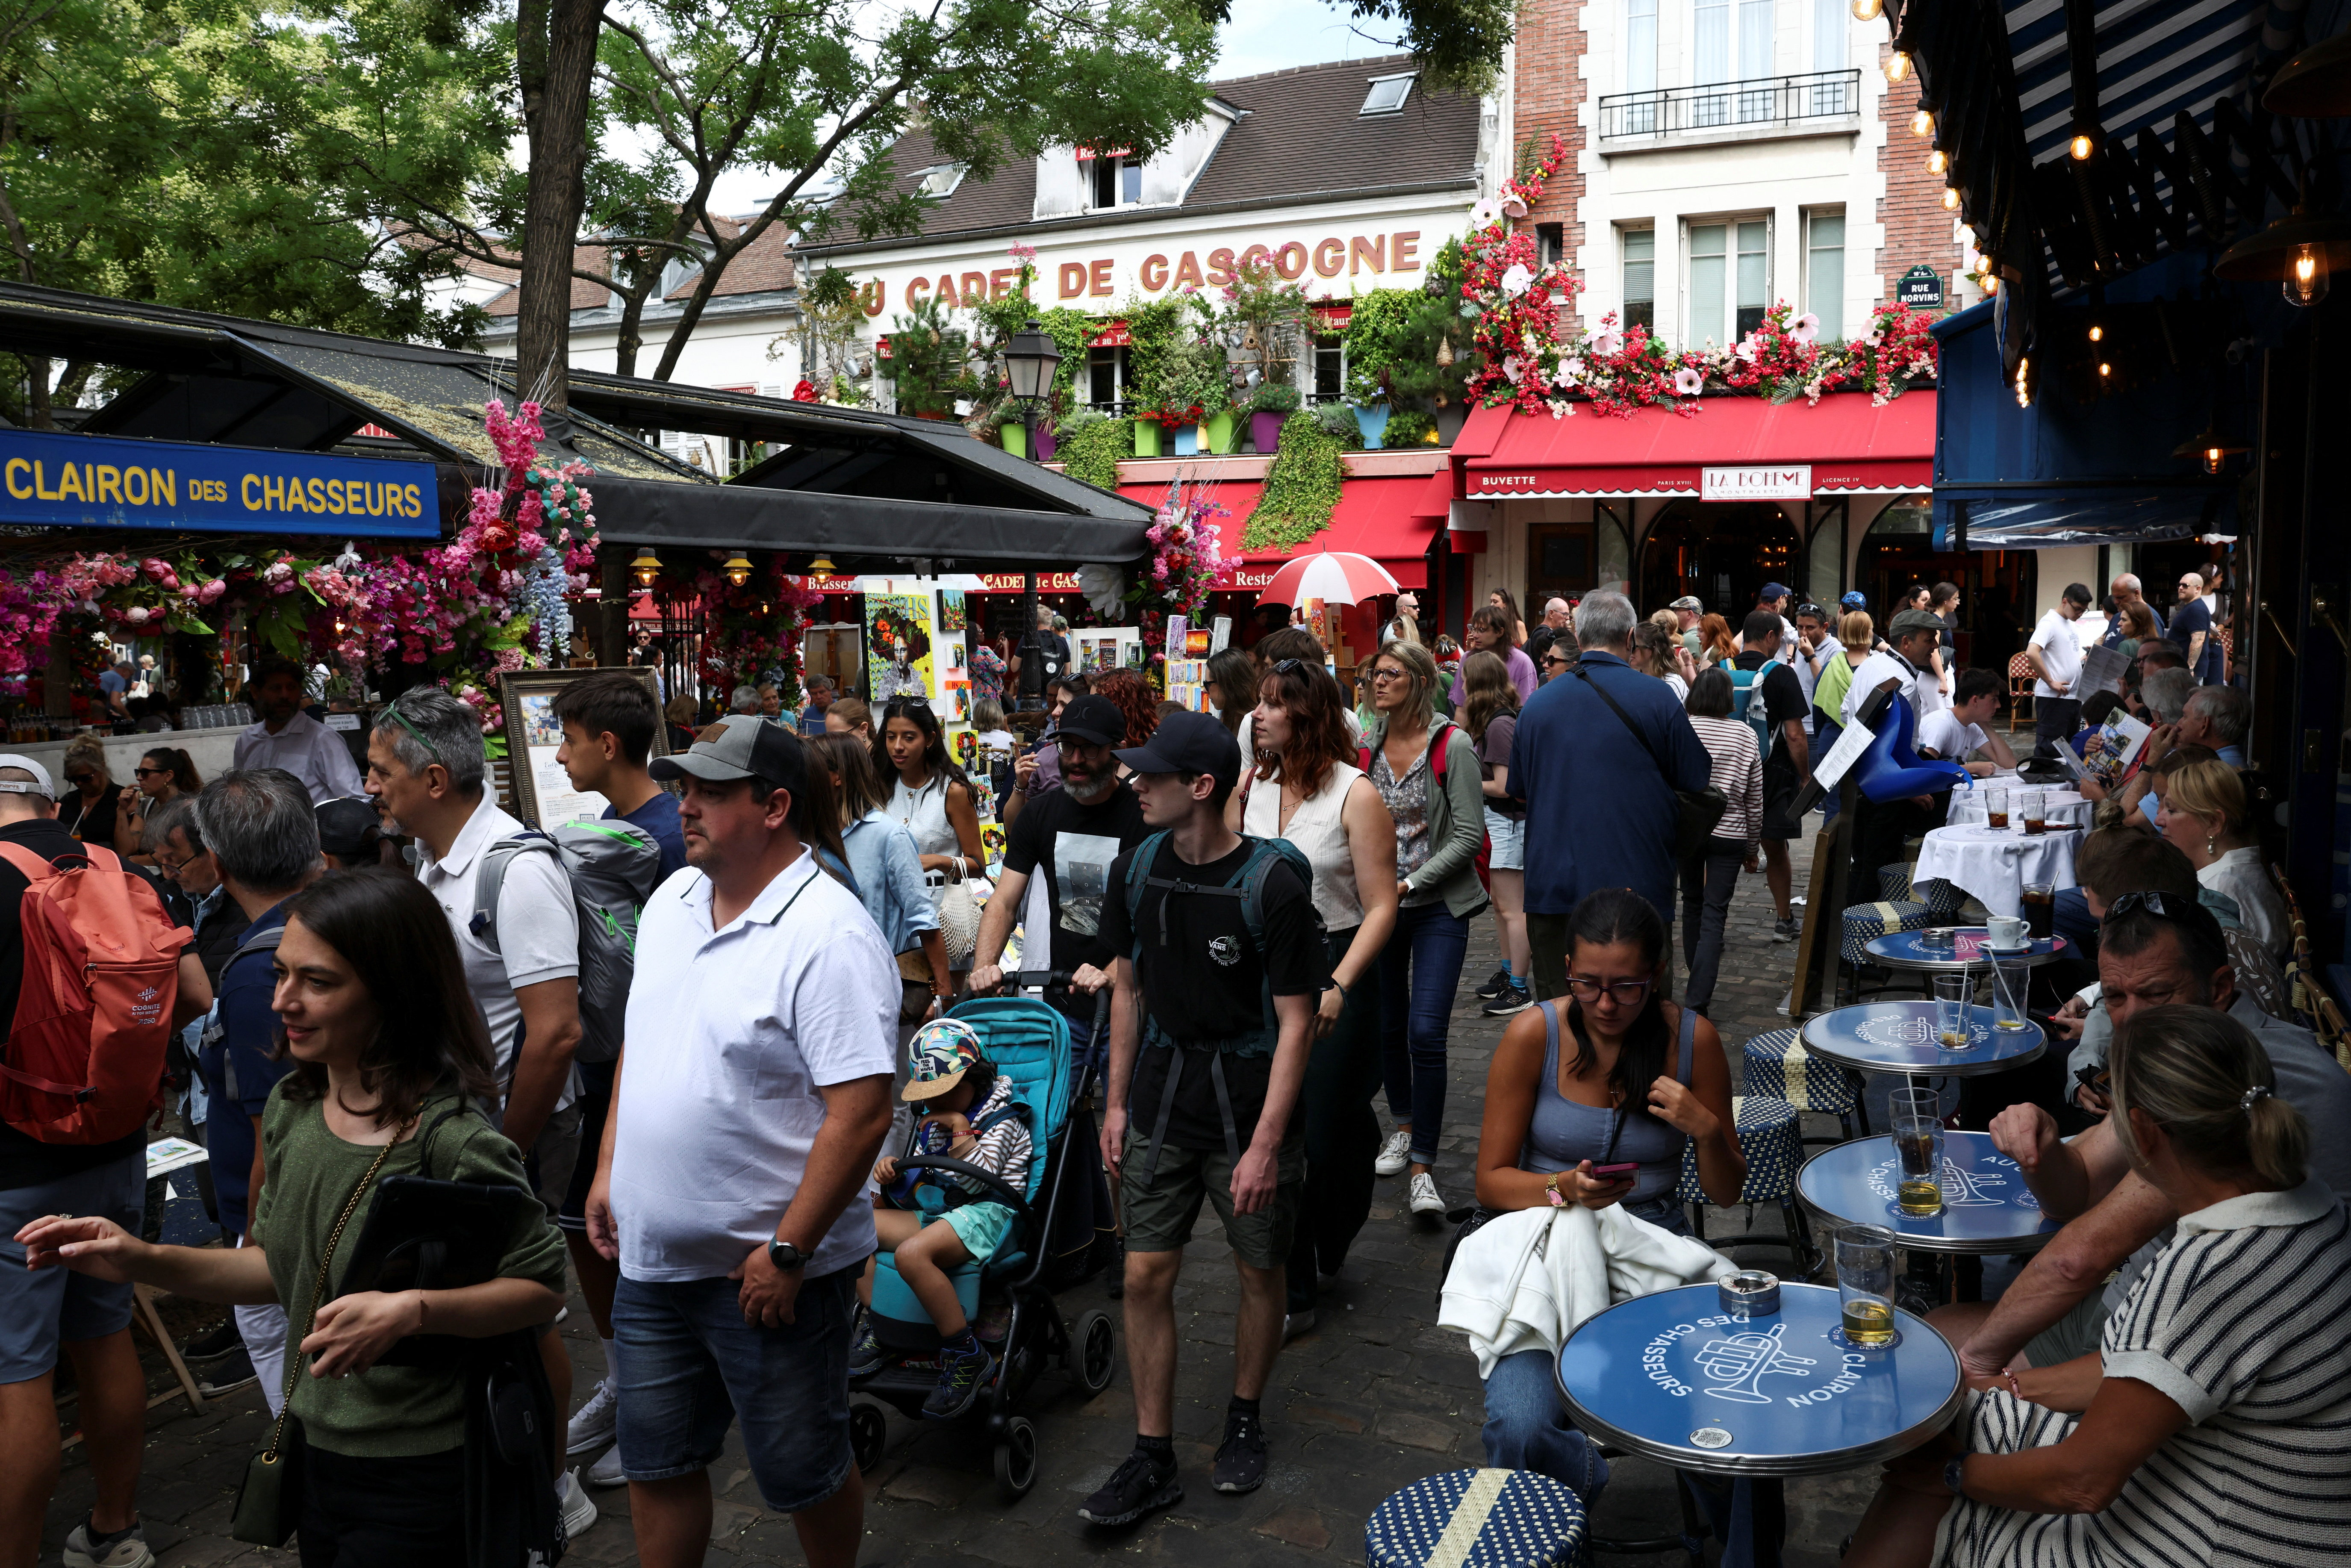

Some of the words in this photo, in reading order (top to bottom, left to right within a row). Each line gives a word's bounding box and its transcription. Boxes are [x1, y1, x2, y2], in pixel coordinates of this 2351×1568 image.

[1058, 259, 1114, 301] DE
[1140, 231, 1420, 293] GASCOGNE
[1912, 284, 1929, 292] RUE
[1901, 293, 1939, 302] NORVINS
[1102, 337, 1111, 345] au
[1482, 476, 1535, 485] BUVETTE
[1710, 473, 1728, 487] LA
[5, 457, 177, 507] CLAIRON
[189, 479, 228, 503] DES
[241, 473, 421, 518] CHASSEURS
[807, 577, 853, 590] Brasser
[1235, 572, 1273, 586] Resta
[903, 596, 929, 620] HS
[1208, 940, 1227, 951] VANS
[1855, 1021, 1902, 1048] CHASSEURS
[1980, 1156, 2017, 1166] AU
[1868, 1168, 1900, 1200] CHASSE
[2016, 1199, 2039, 1208] LAIRON
[1642, 1324, 1696, 1397] CHASSEURS
[1786, 1353, 1866, 1408] CLAIRON
